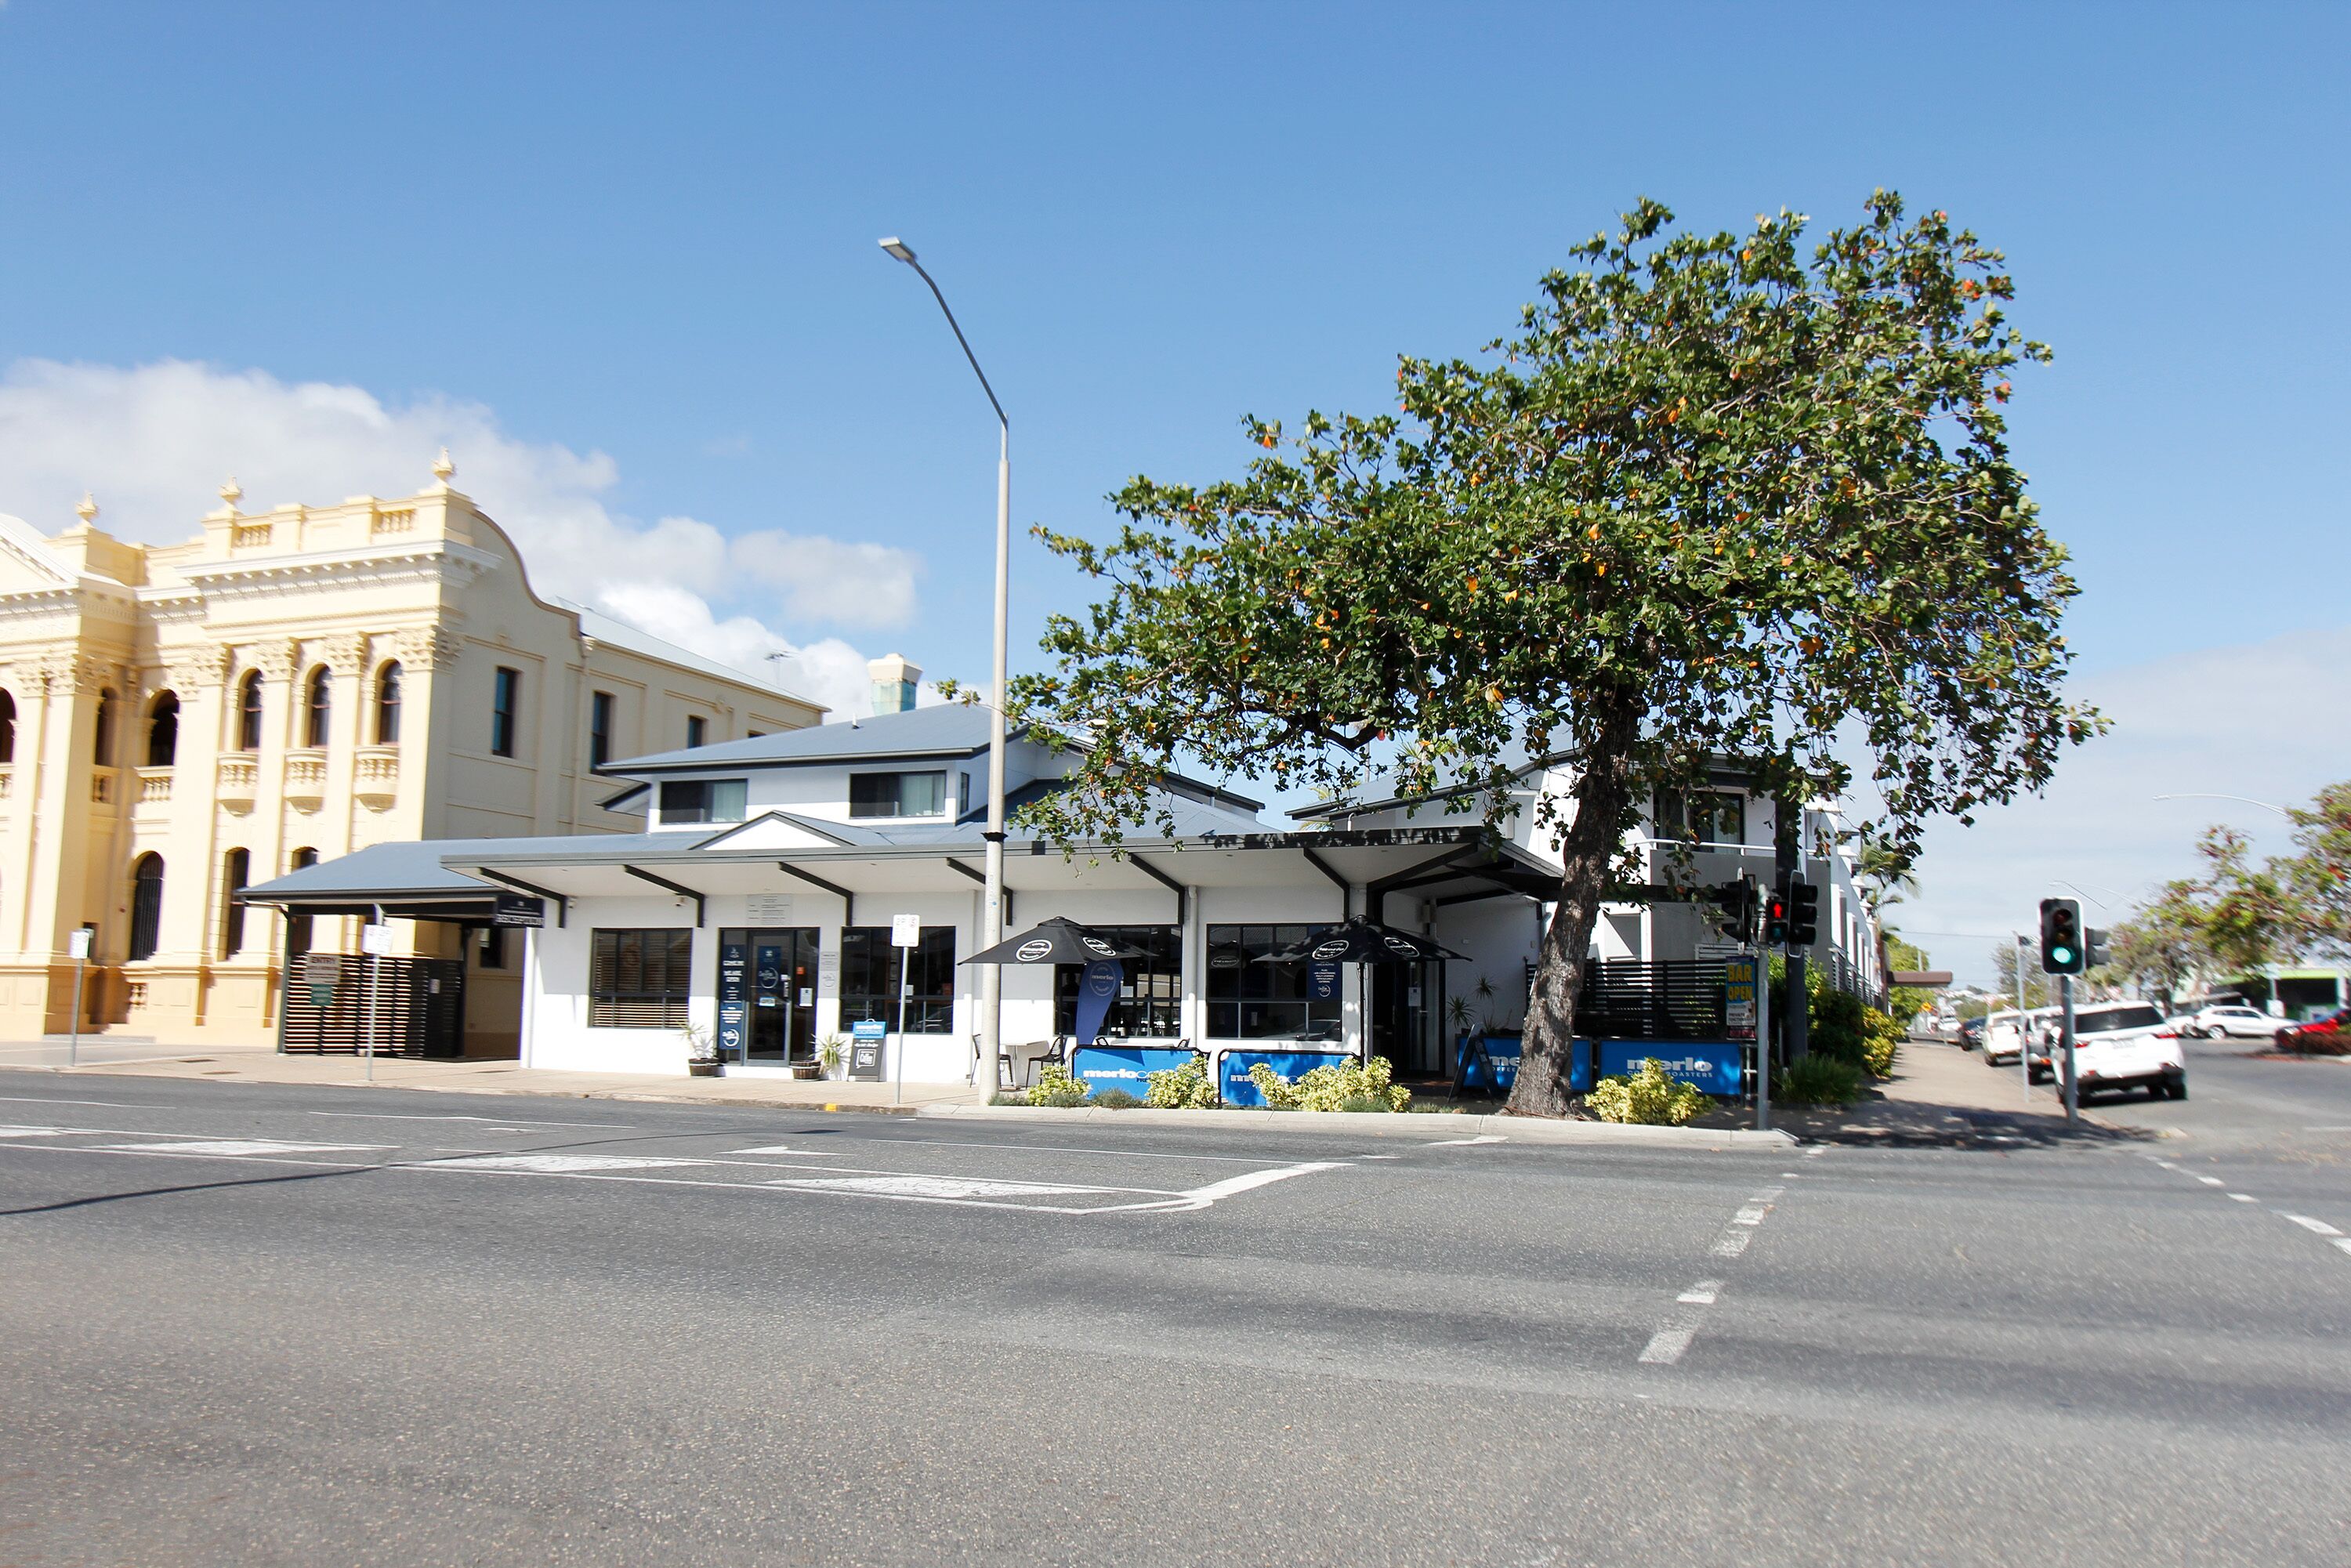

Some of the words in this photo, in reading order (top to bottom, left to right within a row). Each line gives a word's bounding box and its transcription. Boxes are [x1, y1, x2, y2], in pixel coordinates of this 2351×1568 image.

[1727, 965, 1752, 983] BAR
[1728, 986, 1752, 1001] OPEN
[1627, 1057, 1713, 1072] merlo
